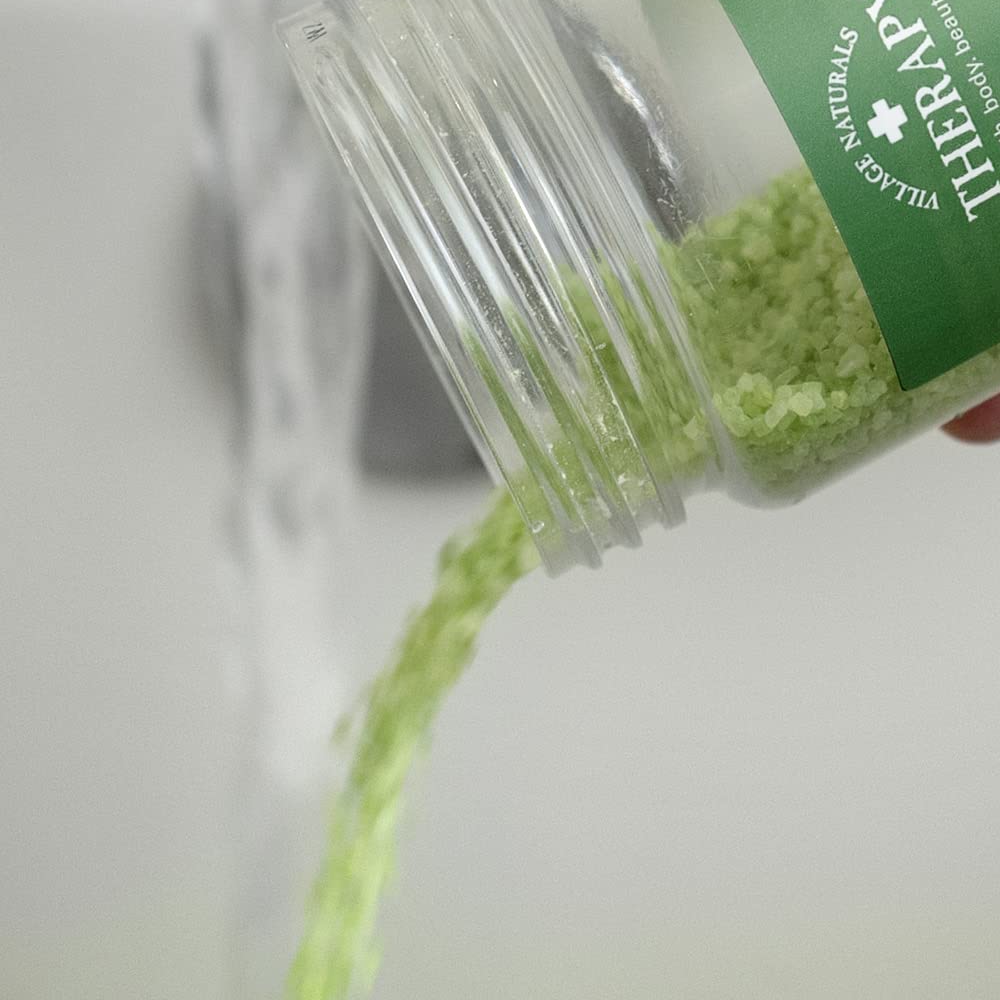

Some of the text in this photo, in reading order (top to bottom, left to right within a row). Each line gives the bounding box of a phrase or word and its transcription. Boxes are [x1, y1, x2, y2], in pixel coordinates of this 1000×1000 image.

[828, 26, 940, 211] VILLAGE NATURALS
[965, 56, 1000, 115] body.
